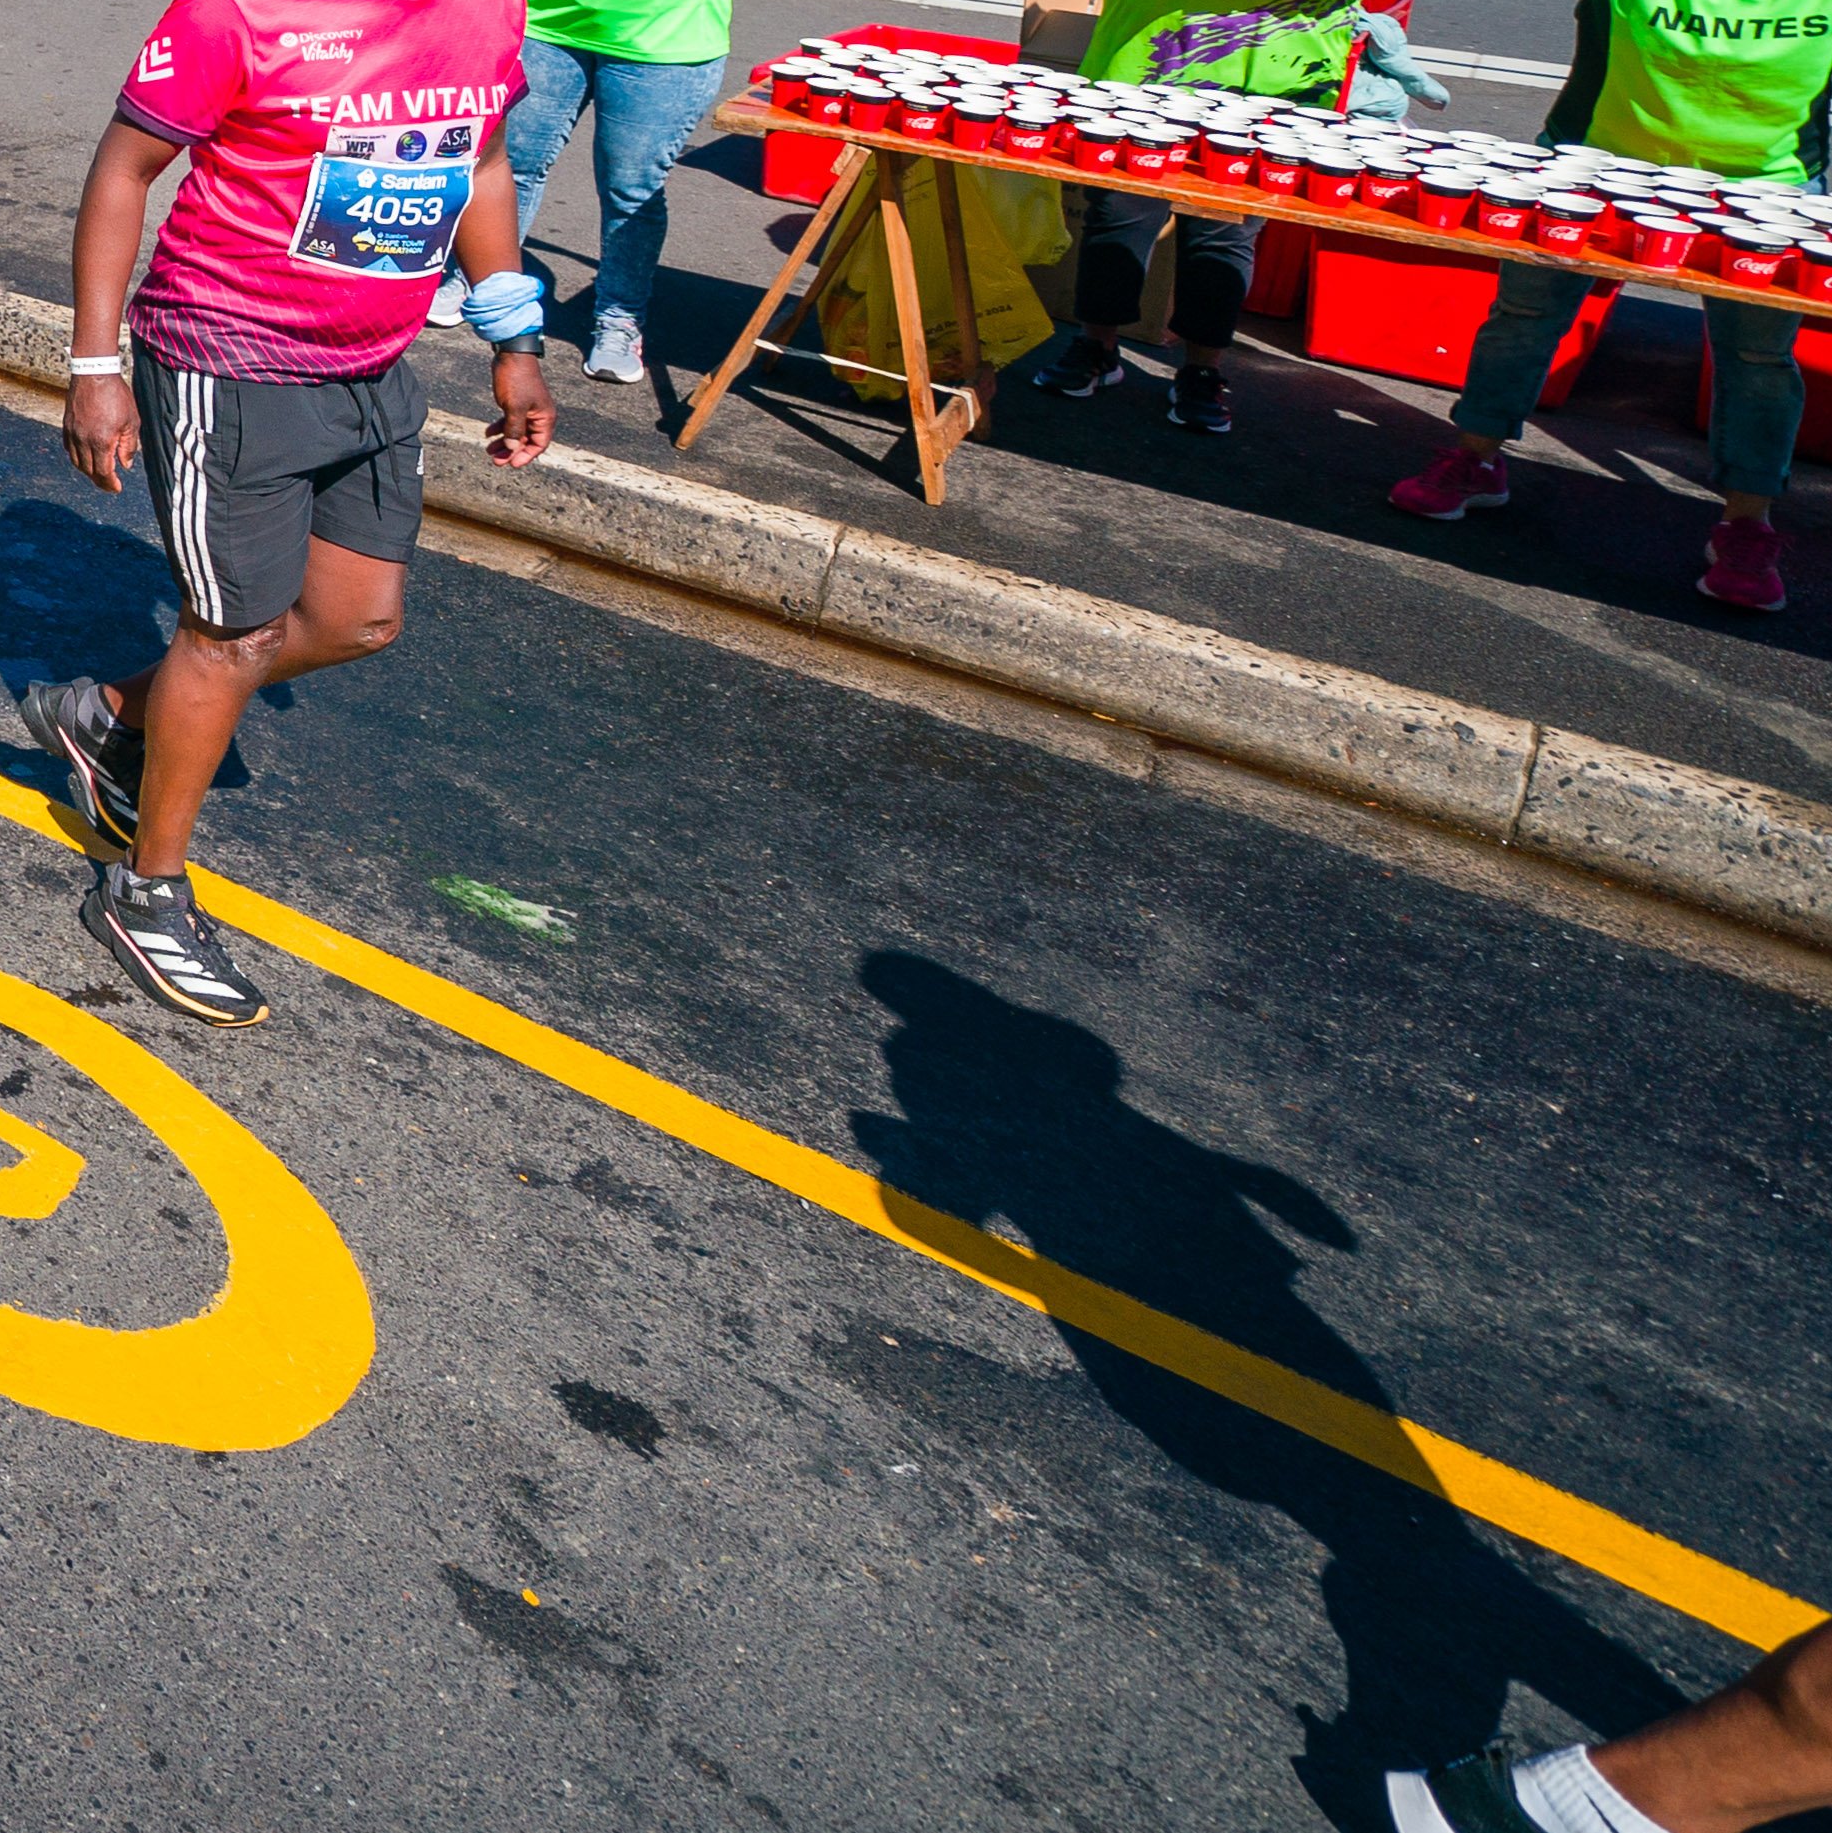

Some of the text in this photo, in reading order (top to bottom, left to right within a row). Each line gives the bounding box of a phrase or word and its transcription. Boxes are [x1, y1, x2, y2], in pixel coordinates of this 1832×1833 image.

[1649, 4, 1830, 41] NANTES
[299, 28, 363, 43] Discovery
[301, 42, 354, 64] Vitality
[282, 91, 394, 124] TEAM
[345, 140, 376, 153] WPA
[440, 128, 471, 147] ASA
[380, 173, 448, 191] Sanlam
[346, 195, 444, 226] 4053
[310, 238, 336, 252] ASA
